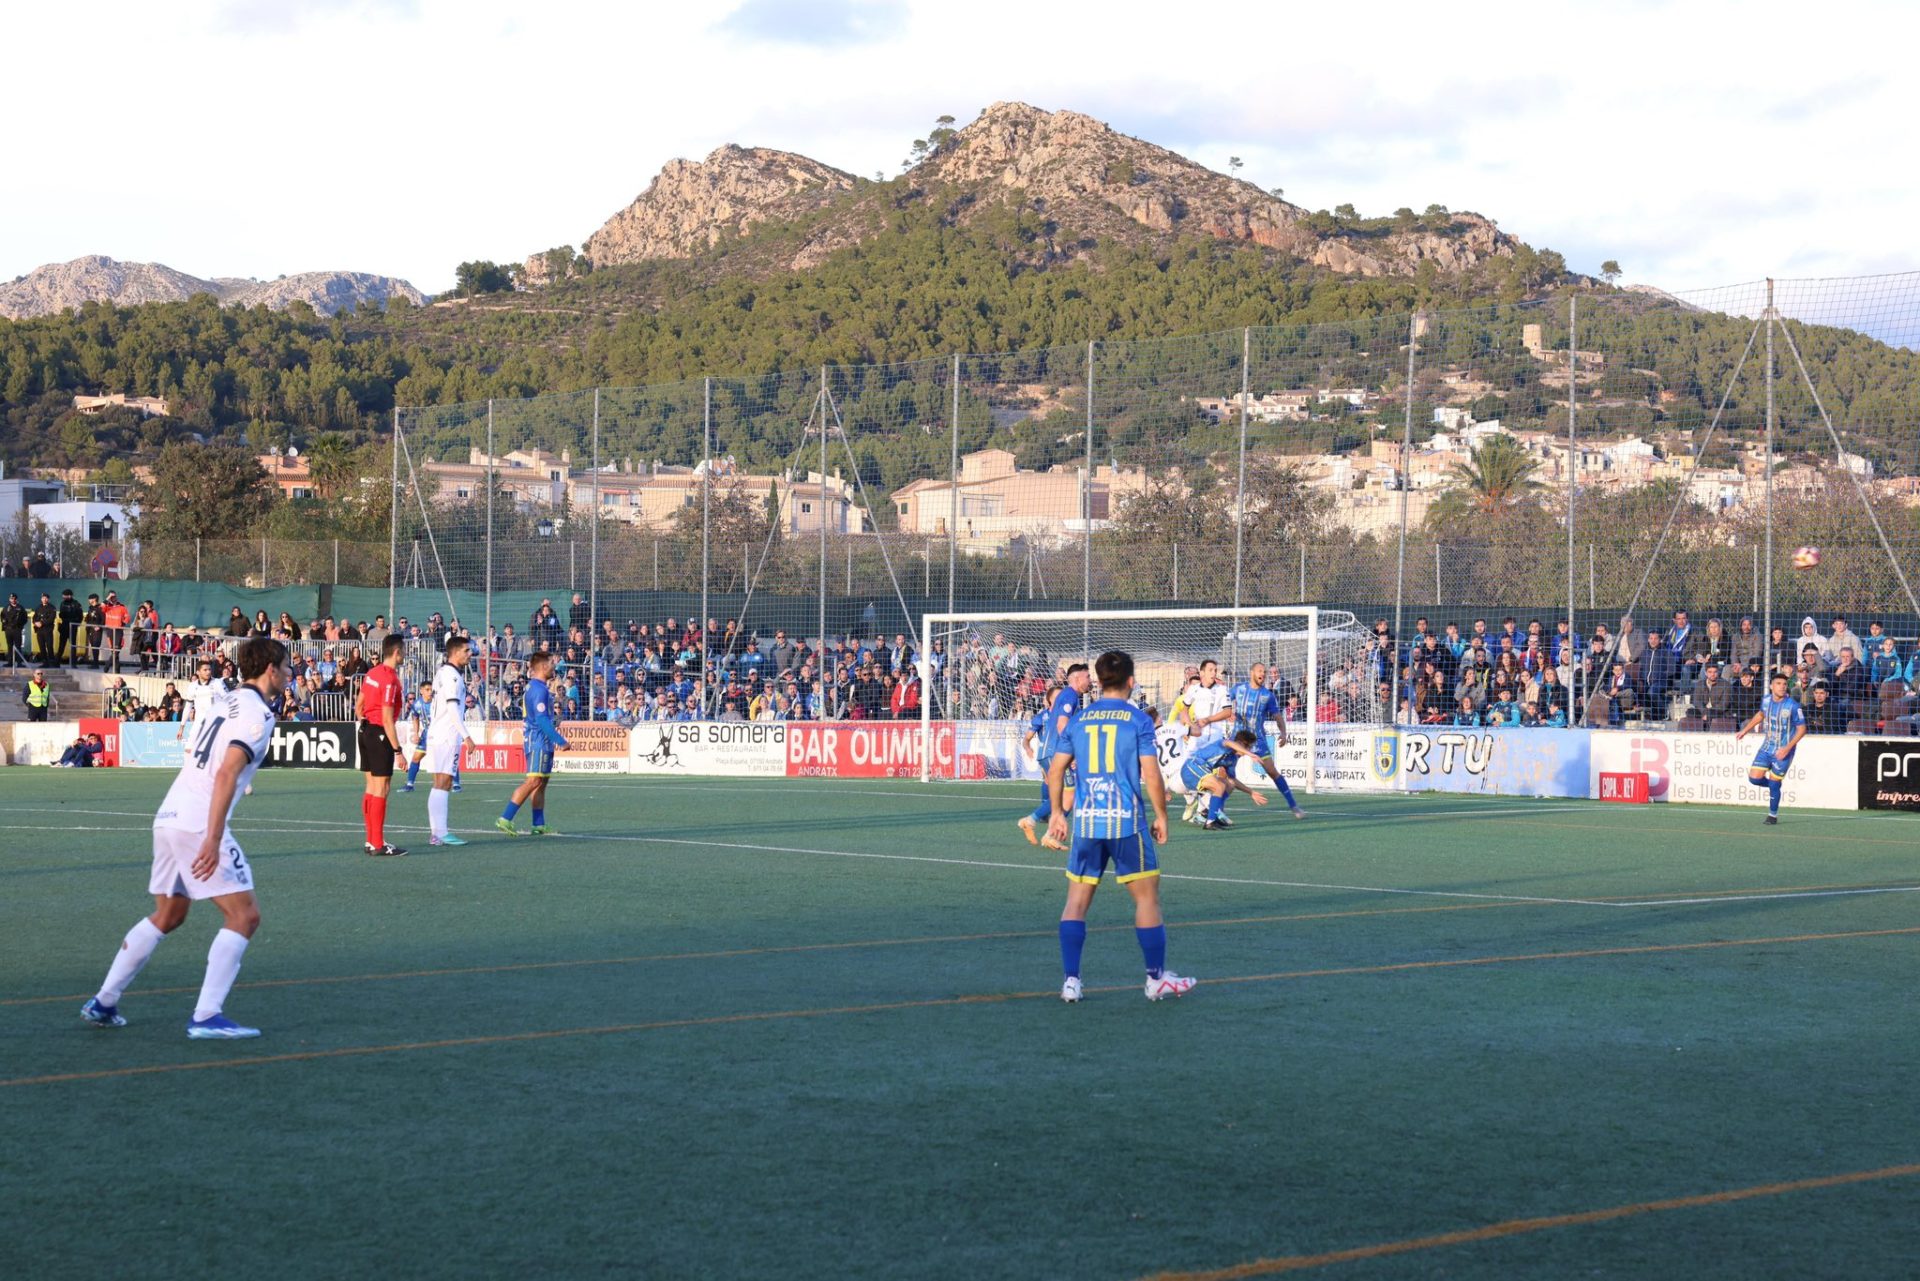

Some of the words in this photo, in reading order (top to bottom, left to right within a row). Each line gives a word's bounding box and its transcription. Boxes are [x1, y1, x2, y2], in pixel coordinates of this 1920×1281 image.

[1079, 710, 1132, 721] J.CASTEDO
[556, 727, 627, 739] ONSTRUCCIONES
[678, 725, 700, 743] sa
[708, 725, 784, 744] somera
[1286, 734, 1307, 746] Aban
[105, 735, 117, 752] REY
[264, 727, 340, 762] tnia
[588, 741, 613, 751] CAUBET
[615, 741, 627, 752] S.L.
[717, 745, 767, 753] RESTAURANTE
[790, 728, 838, 765] BAR
[850, 727, 952, 766] OLIMPIC
[1085, 724, 1118, 773] 11
[1674, 739, 1702, 755] Ens
[1706, 739, 1753, 757] Públic
[466, 750, 485, 769] COPA
[494, 750, 508, 770] REY
[1155, 737, 1181, 767] 22
[583, 761, 595, 770] 639
[595, 761, 606, 770] 971
[607, 761, 619, 770] 346
[798, 766, 838, 777] ANDRATX
[898, 767, 911, 777] 971
[1280, 769, 1321, 780] ESPOS
[1323, 771, 1366, 780] ANDRATX
[1602, 777, 1617, 798] COPA
[1623, 778, 1635, 798] REY
[1673, 783, 1695, 799] les
[1699, 784, 1732, 800] Illes
[1738, 786, 1797, 803] Balers
[1876, 790, 1920, 805] impre
